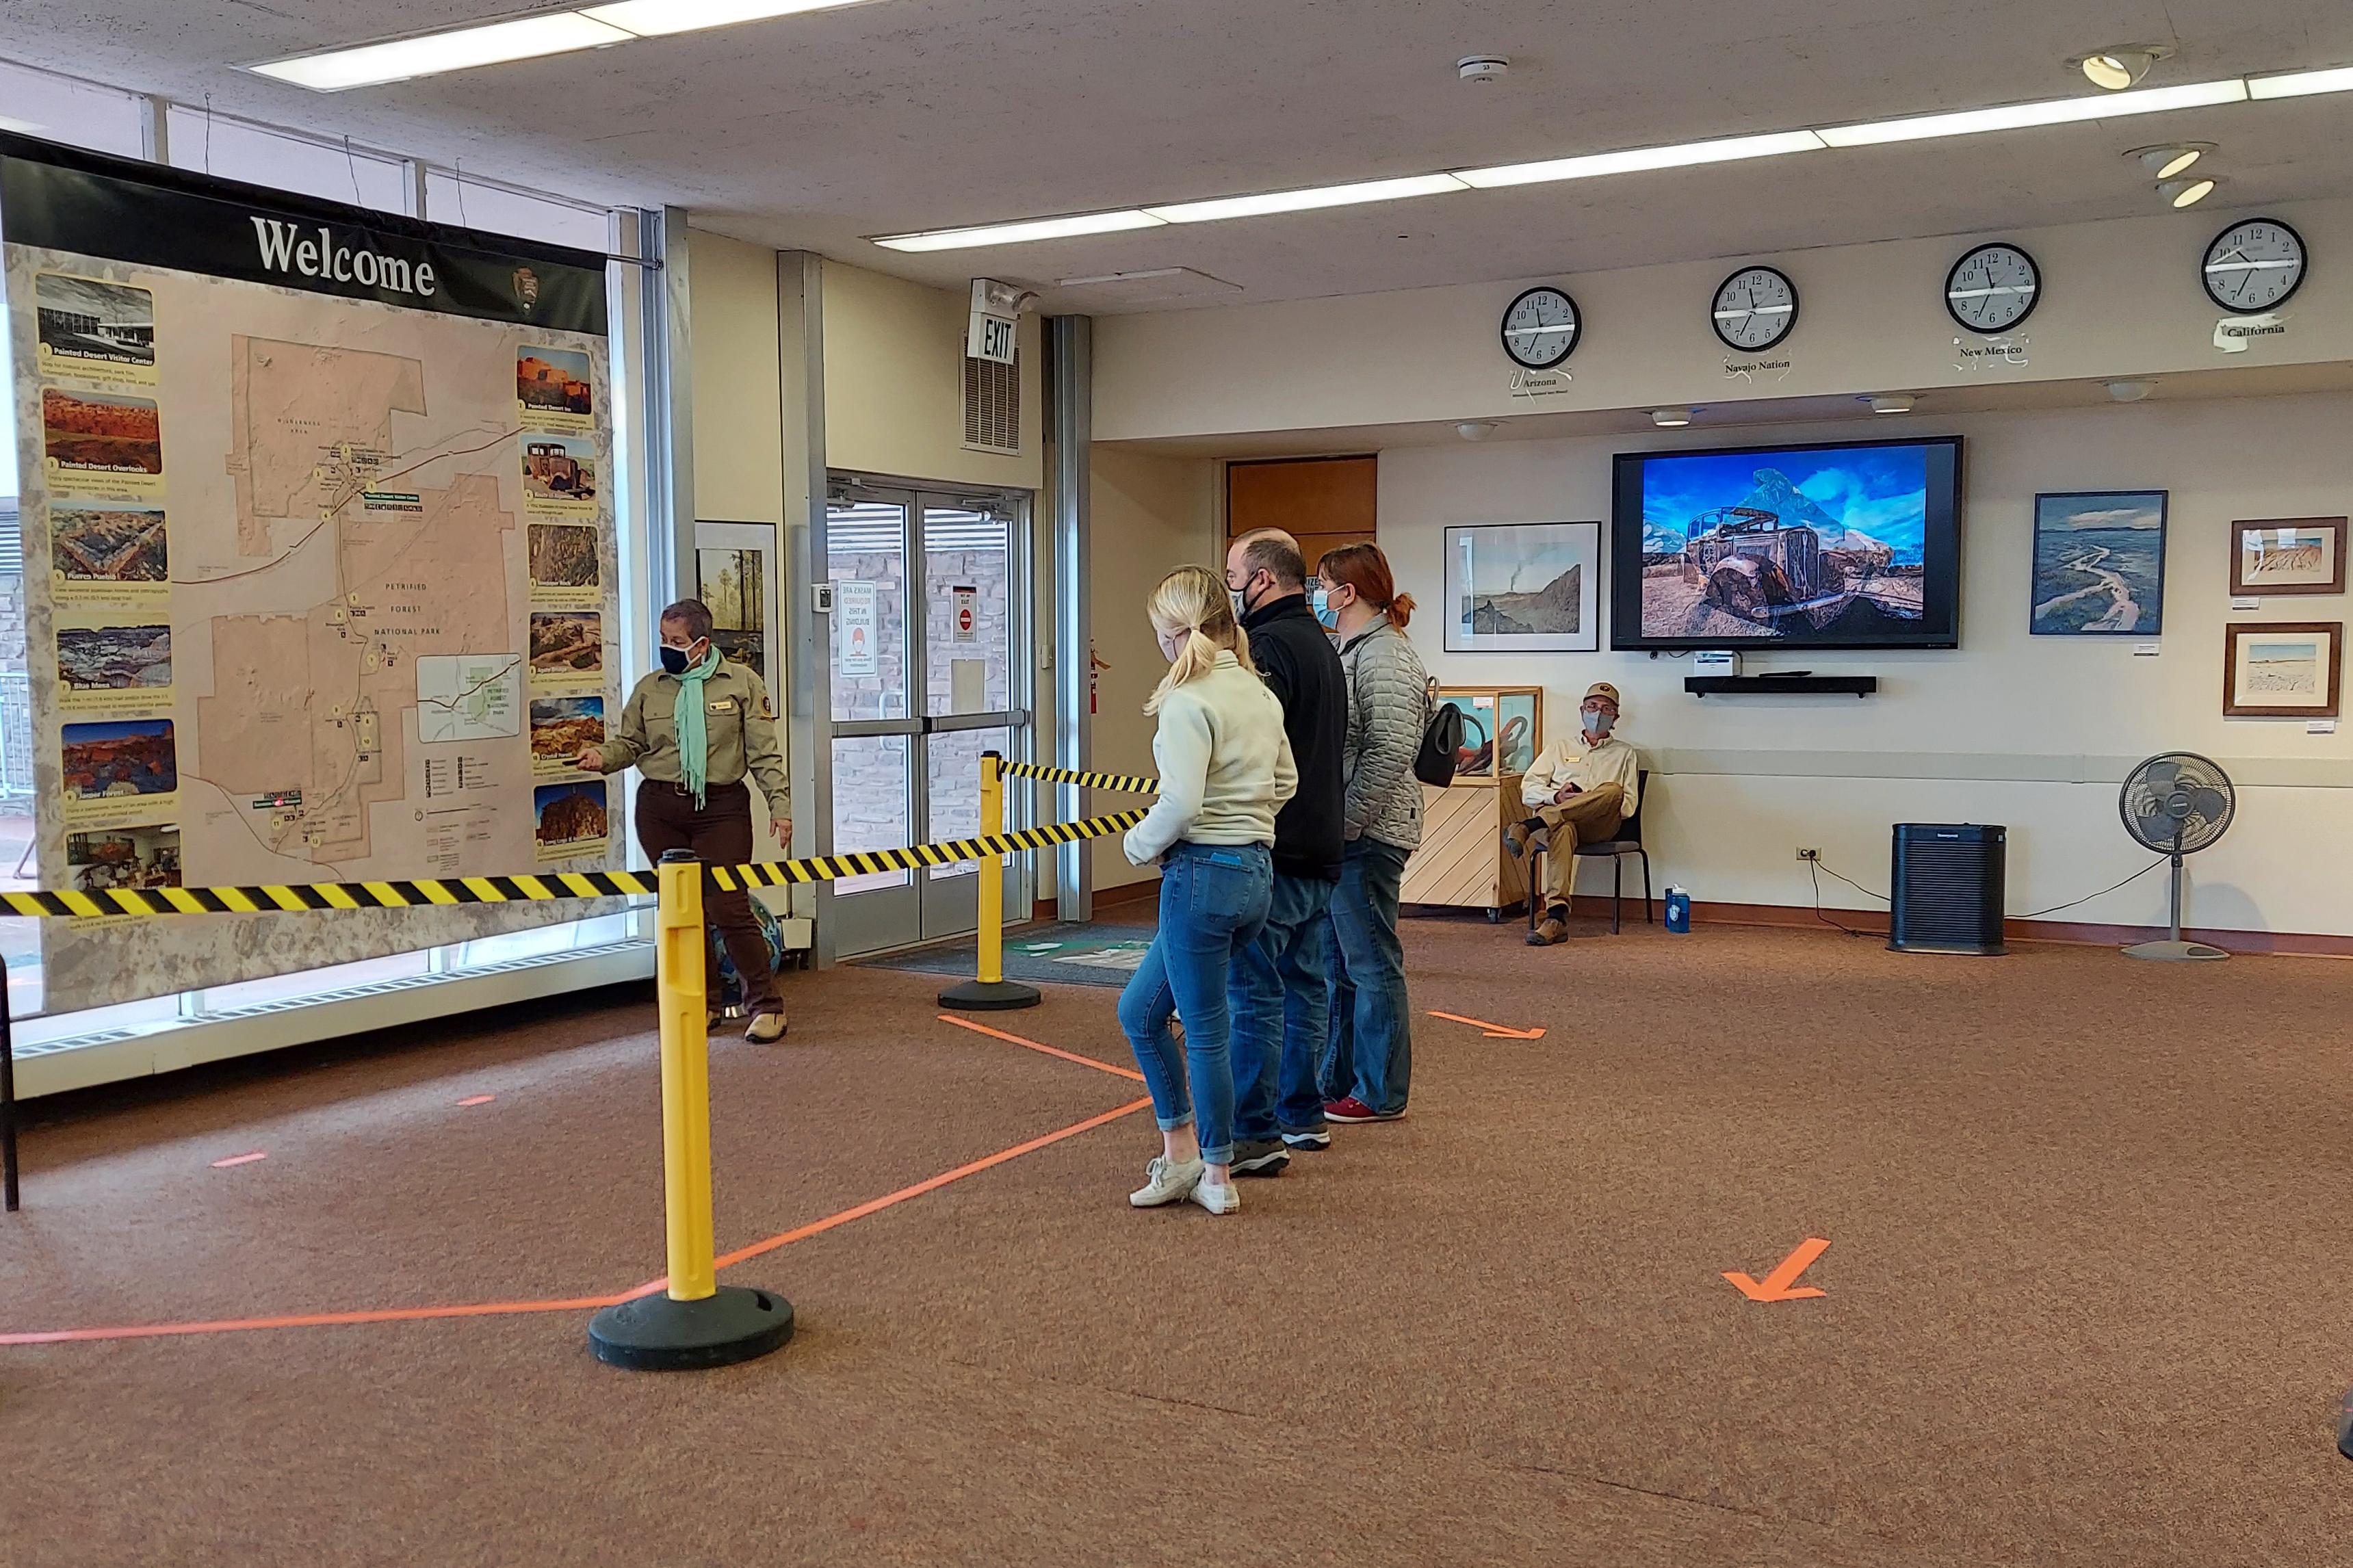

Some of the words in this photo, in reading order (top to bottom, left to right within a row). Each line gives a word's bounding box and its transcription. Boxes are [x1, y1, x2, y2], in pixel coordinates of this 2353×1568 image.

[2250, 228, 2262, 239] 12
[2272, 232, 2275, 242] 1
[2233, 235, 2243, 245] 11
[2283, 242, 2289, 252] 2
[250, 215, 436, 296] Welcome
[1987, 253, 1999, 263] 12
[1973, 259, 1983, 270] 11
[2007, 256, 2012, 265] 1
[2018, 265, 2025, 275] 2
[1752, 275, 1762, 285] 12
[1962, 271, 1973, 281] 10
[2280, 275, 2286, 285] 4
[1738, 280, 1745, 289] 11
[1769, 279, 1772, 288] 1
[2218, 280, 2225, 289] 8
[1727, 292, 1736, 301] 10
[1778, 288, 1783, 298] 2
[2231, 291, 2237, 300] 7
[2268, 288, 2274, 298] 5
[1538, 296, 1547, 305] 12
[2018, 296, 2023, 304] 4
[2248, 293, 2255, 303] 6
[1526, 301, 1535, 310] 11
[1554, 300, 1558, 308] 1
[1961, 301, 1967, 311] 8
[1517, 311, 1526, 319] 10
[1563, 309, 1568, 318] 2
[1973, 311, 1979, 320] 7
[2006, 308, 2012, 317] 5
[1989, 313, 1995, 322] 6
[1725, 320, 1730, 329] 8
[1776, 318, 1780, 328] 4
[1735, 330, 1740, 339] 7
[1765, 329, 1770, 338] 5
[2228, 325, 2285, 337] California
[985, 319, 1011, 359] EXIT
[1514, 337, 1519, 346] 8
[1750, 333, 1755, 342] 6
[1523, 348, 1529, 356] 7
[1537, 350, 1542, 359] 6
[1550, 346, 1556, 355] 5
[1960, 348, 1982, 357] New
[1984, 346, 2022, 356] Mexico
[54, 348, 82, 357] Painted
[83, 351, 107, 360] Desert
[109, 354, 130, 363] Visitor
[131, 357, 153, 365] Center
[1726, 365, 1756, 374] Navajo
[1759, 361, 1790, 369] Nation
[1523, 379, 1557, 388] Arizona
[61, 460, 87, 469] Painted
[88, 463, 112, 471] Desert
[112, 465, 147, 473] Overlooks
